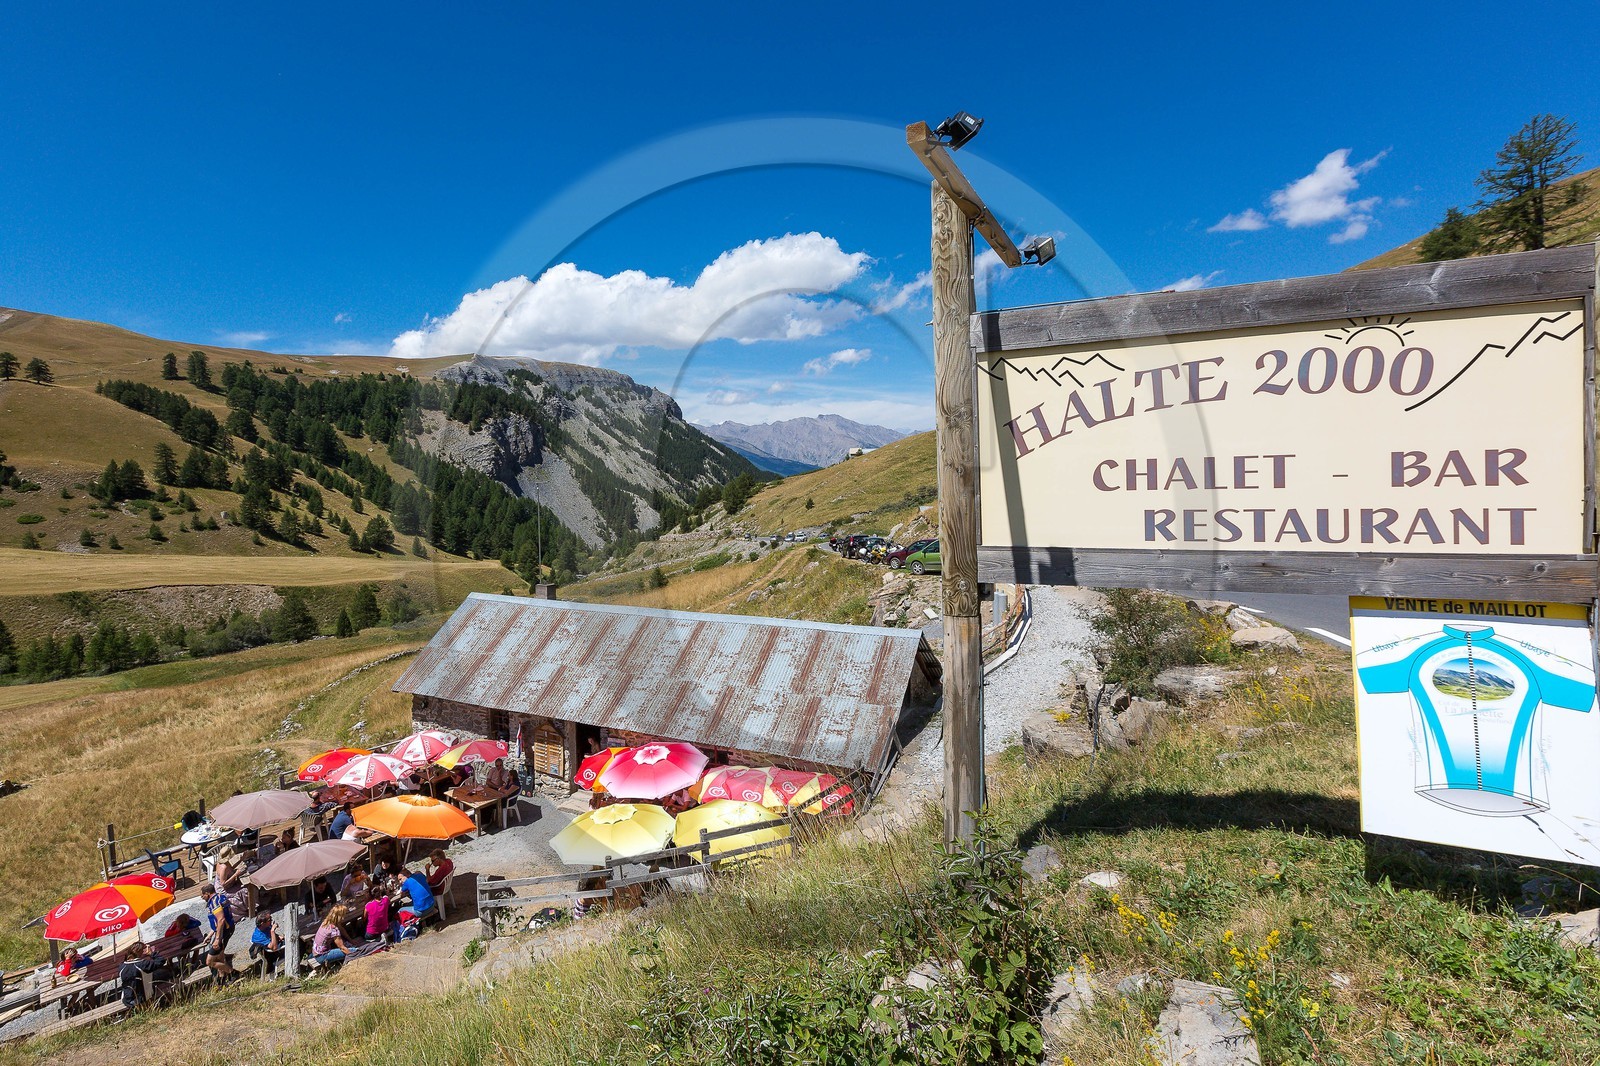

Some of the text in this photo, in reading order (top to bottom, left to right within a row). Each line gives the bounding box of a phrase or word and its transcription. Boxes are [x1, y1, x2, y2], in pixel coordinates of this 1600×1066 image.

[1002, 345, 1434, 460] HALTE 2000
[1092, 454, 1296, 492] CHALET
[1391, 448, 1530, 488] BAR
[1144, 507, 1537, 546] RESTAURANT
[1384, 597, 1547, 618] VENTE de MAILLOT
[101, 923, 122, 934] MIKO
